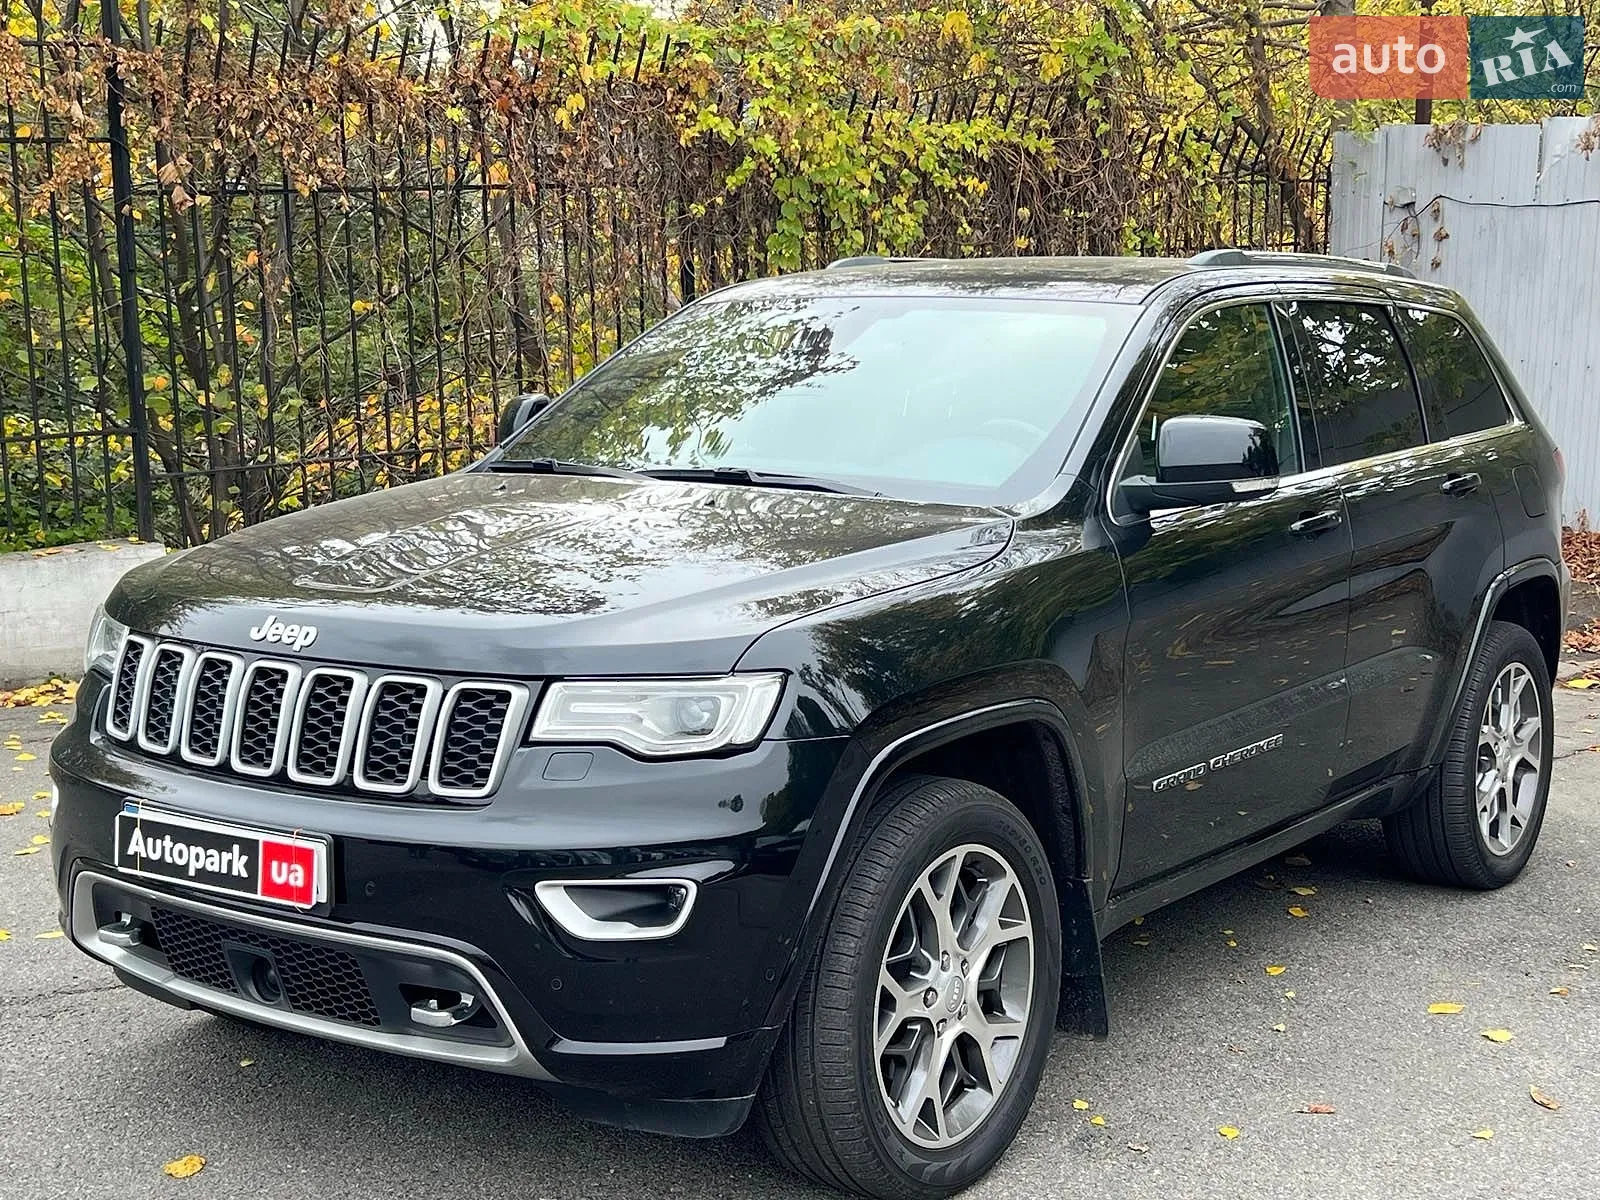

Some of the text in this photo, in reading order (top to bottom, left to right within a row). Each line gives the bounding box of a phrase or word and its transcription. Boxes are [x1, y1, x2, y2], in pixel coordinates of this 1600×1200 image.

[250, 615, 319, 652] Jeep
[1152, 733, 1284, 793] GRAND CHEROKEE
[127, 827, 305, 888] Autopark ua
